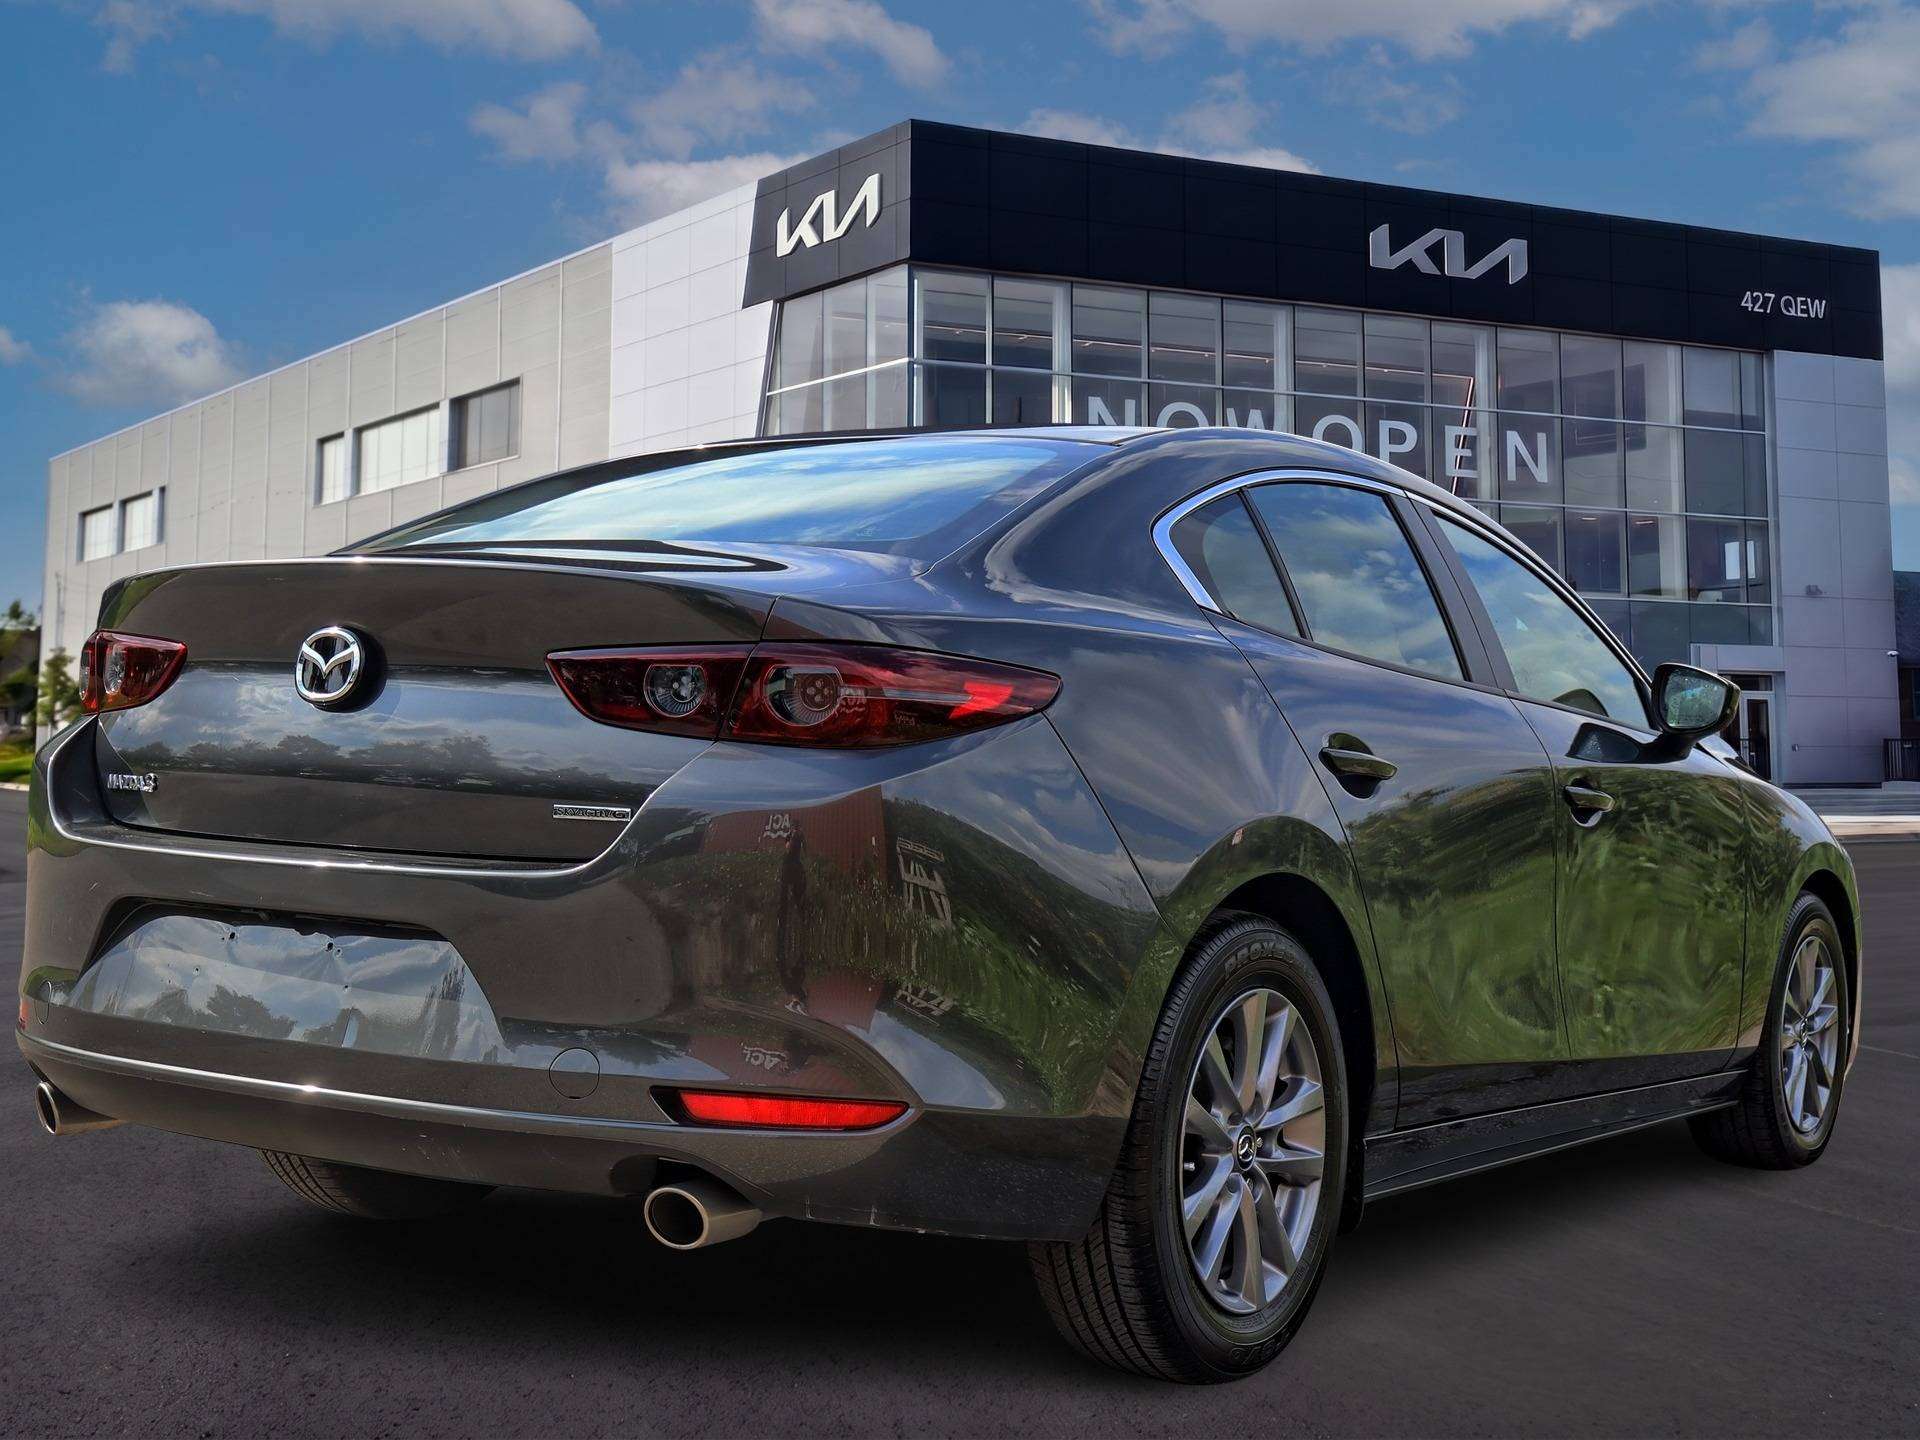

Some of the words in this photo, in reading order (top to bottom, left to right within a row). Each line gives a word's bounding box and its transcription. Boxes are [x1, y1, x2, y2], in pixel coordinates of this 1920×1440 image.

[776, 172, 881, 258] KIA
[1369, 223, 1528, 285] KIA
[1740, 291, 1775, 313] 427
[1780, 295, 1826, 319] QEW
[1312, 414, 1548, 482] OPEN
